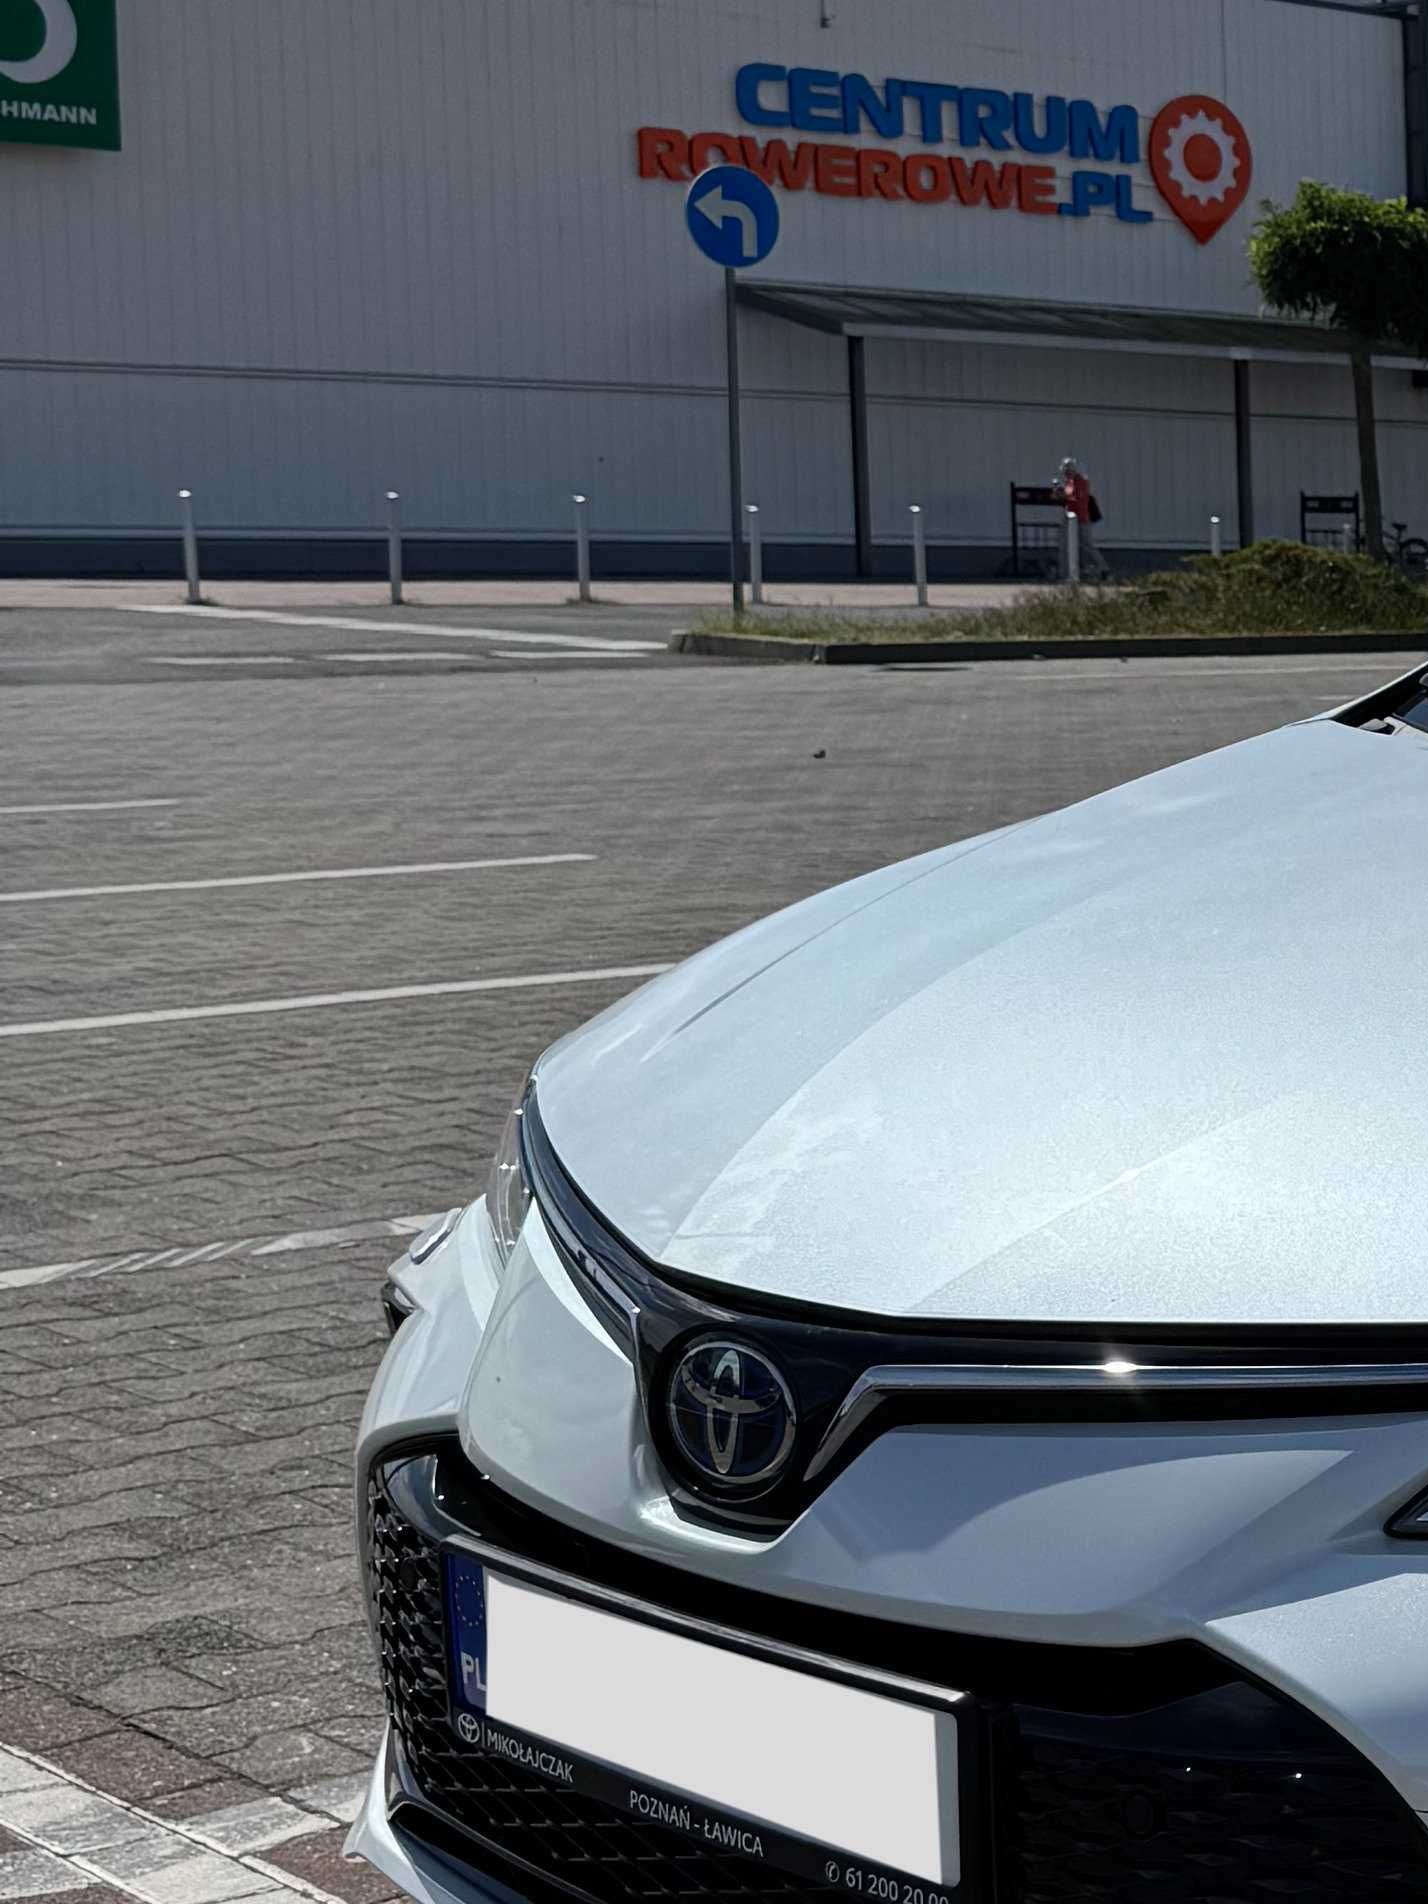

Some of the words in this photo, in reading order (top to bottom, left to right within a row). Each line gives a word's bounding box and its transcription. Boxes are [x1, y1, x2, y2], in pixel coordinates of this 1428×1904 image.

[735, 63, 1140, 163] CENTRUM
[638, 128, 1153, 223] ROWEROWE.PL
[460, 1651, 487, 1691] PL
[486, 1728, 574, 1784] MIKOŁAJCZAK
[630, 1789, 691, 1831] POZNAŃ
[703, 1818, 764, 1858] ŁAWICA
[845, 1867, 862, 1891] 61
[867, 1874, 899, 1902] 200
